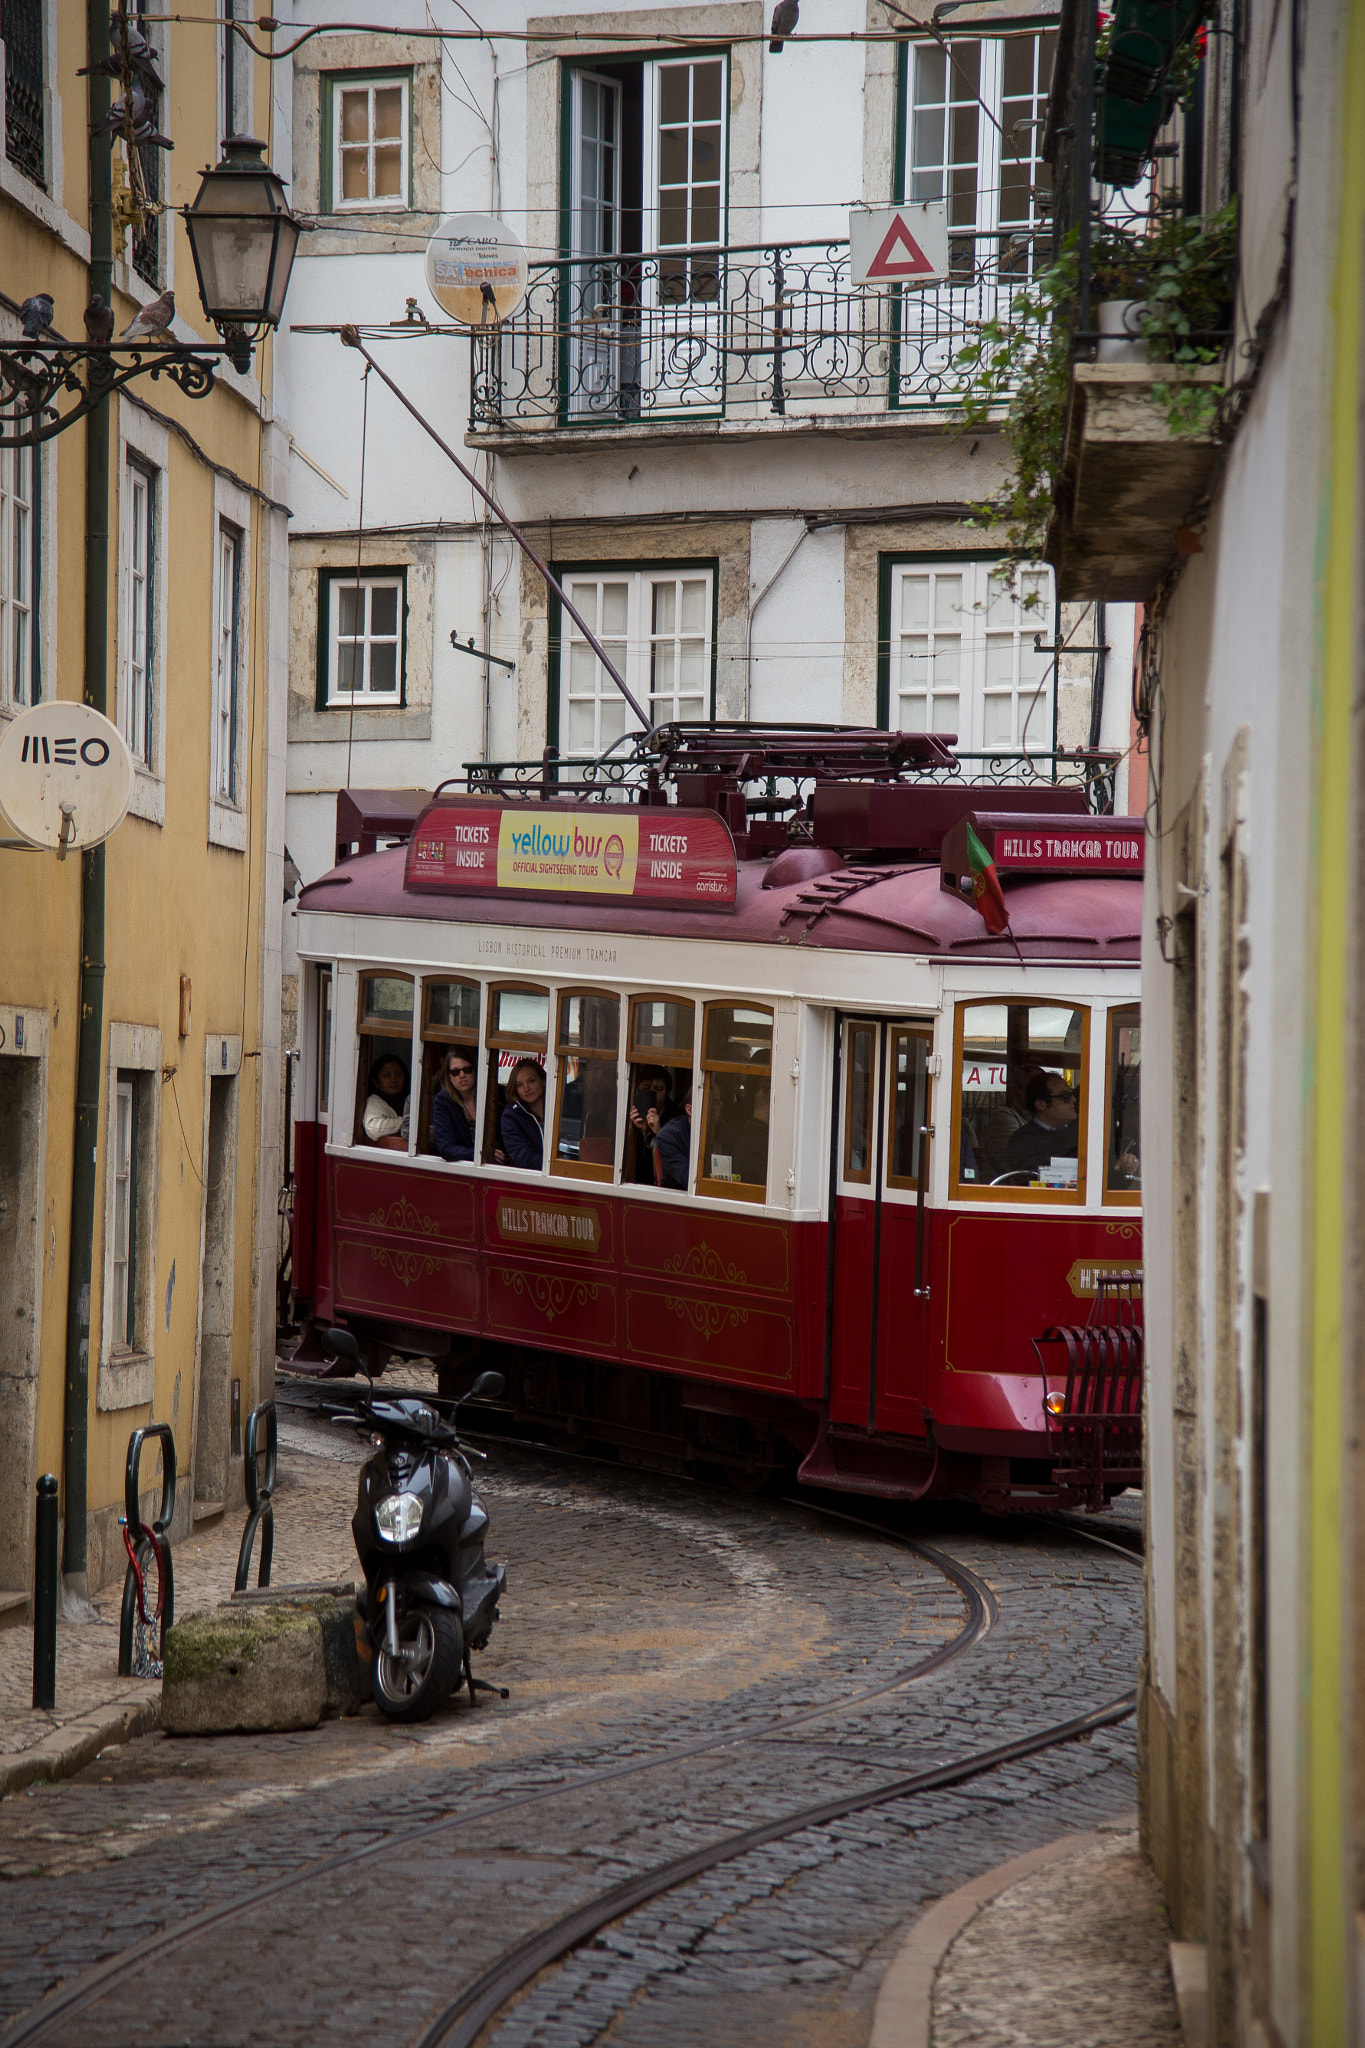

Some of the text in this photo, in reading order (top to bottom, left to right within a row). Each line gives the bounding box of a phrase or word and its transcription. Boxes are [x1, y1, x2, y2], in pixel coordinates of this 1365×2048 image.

[21, 735, 110, 766] MEO
[455, 825, 490, 844] TICKETS
[512, 824, 571, 857] yellow
[573, 826, 603, 858] bus
[649, 834, 688, 853] TICKETS
[456, 850, 485, 868] INSIDE
[1003, 839, 1139, 860] HILLS TRAMCAR TOUR
[513, 861, 599, 877] OFFICIAL SIGHTSEEING TOURS
[650, 861, 683, 880] INSIDE
[478, 940, 617, 963] LISBON HISTORICAL PREMIUM TRAMCAR
[966, 1066, 982, 1085] A
[502, 1208, 595, 1241] HILLS TRAMCAR TOUR
